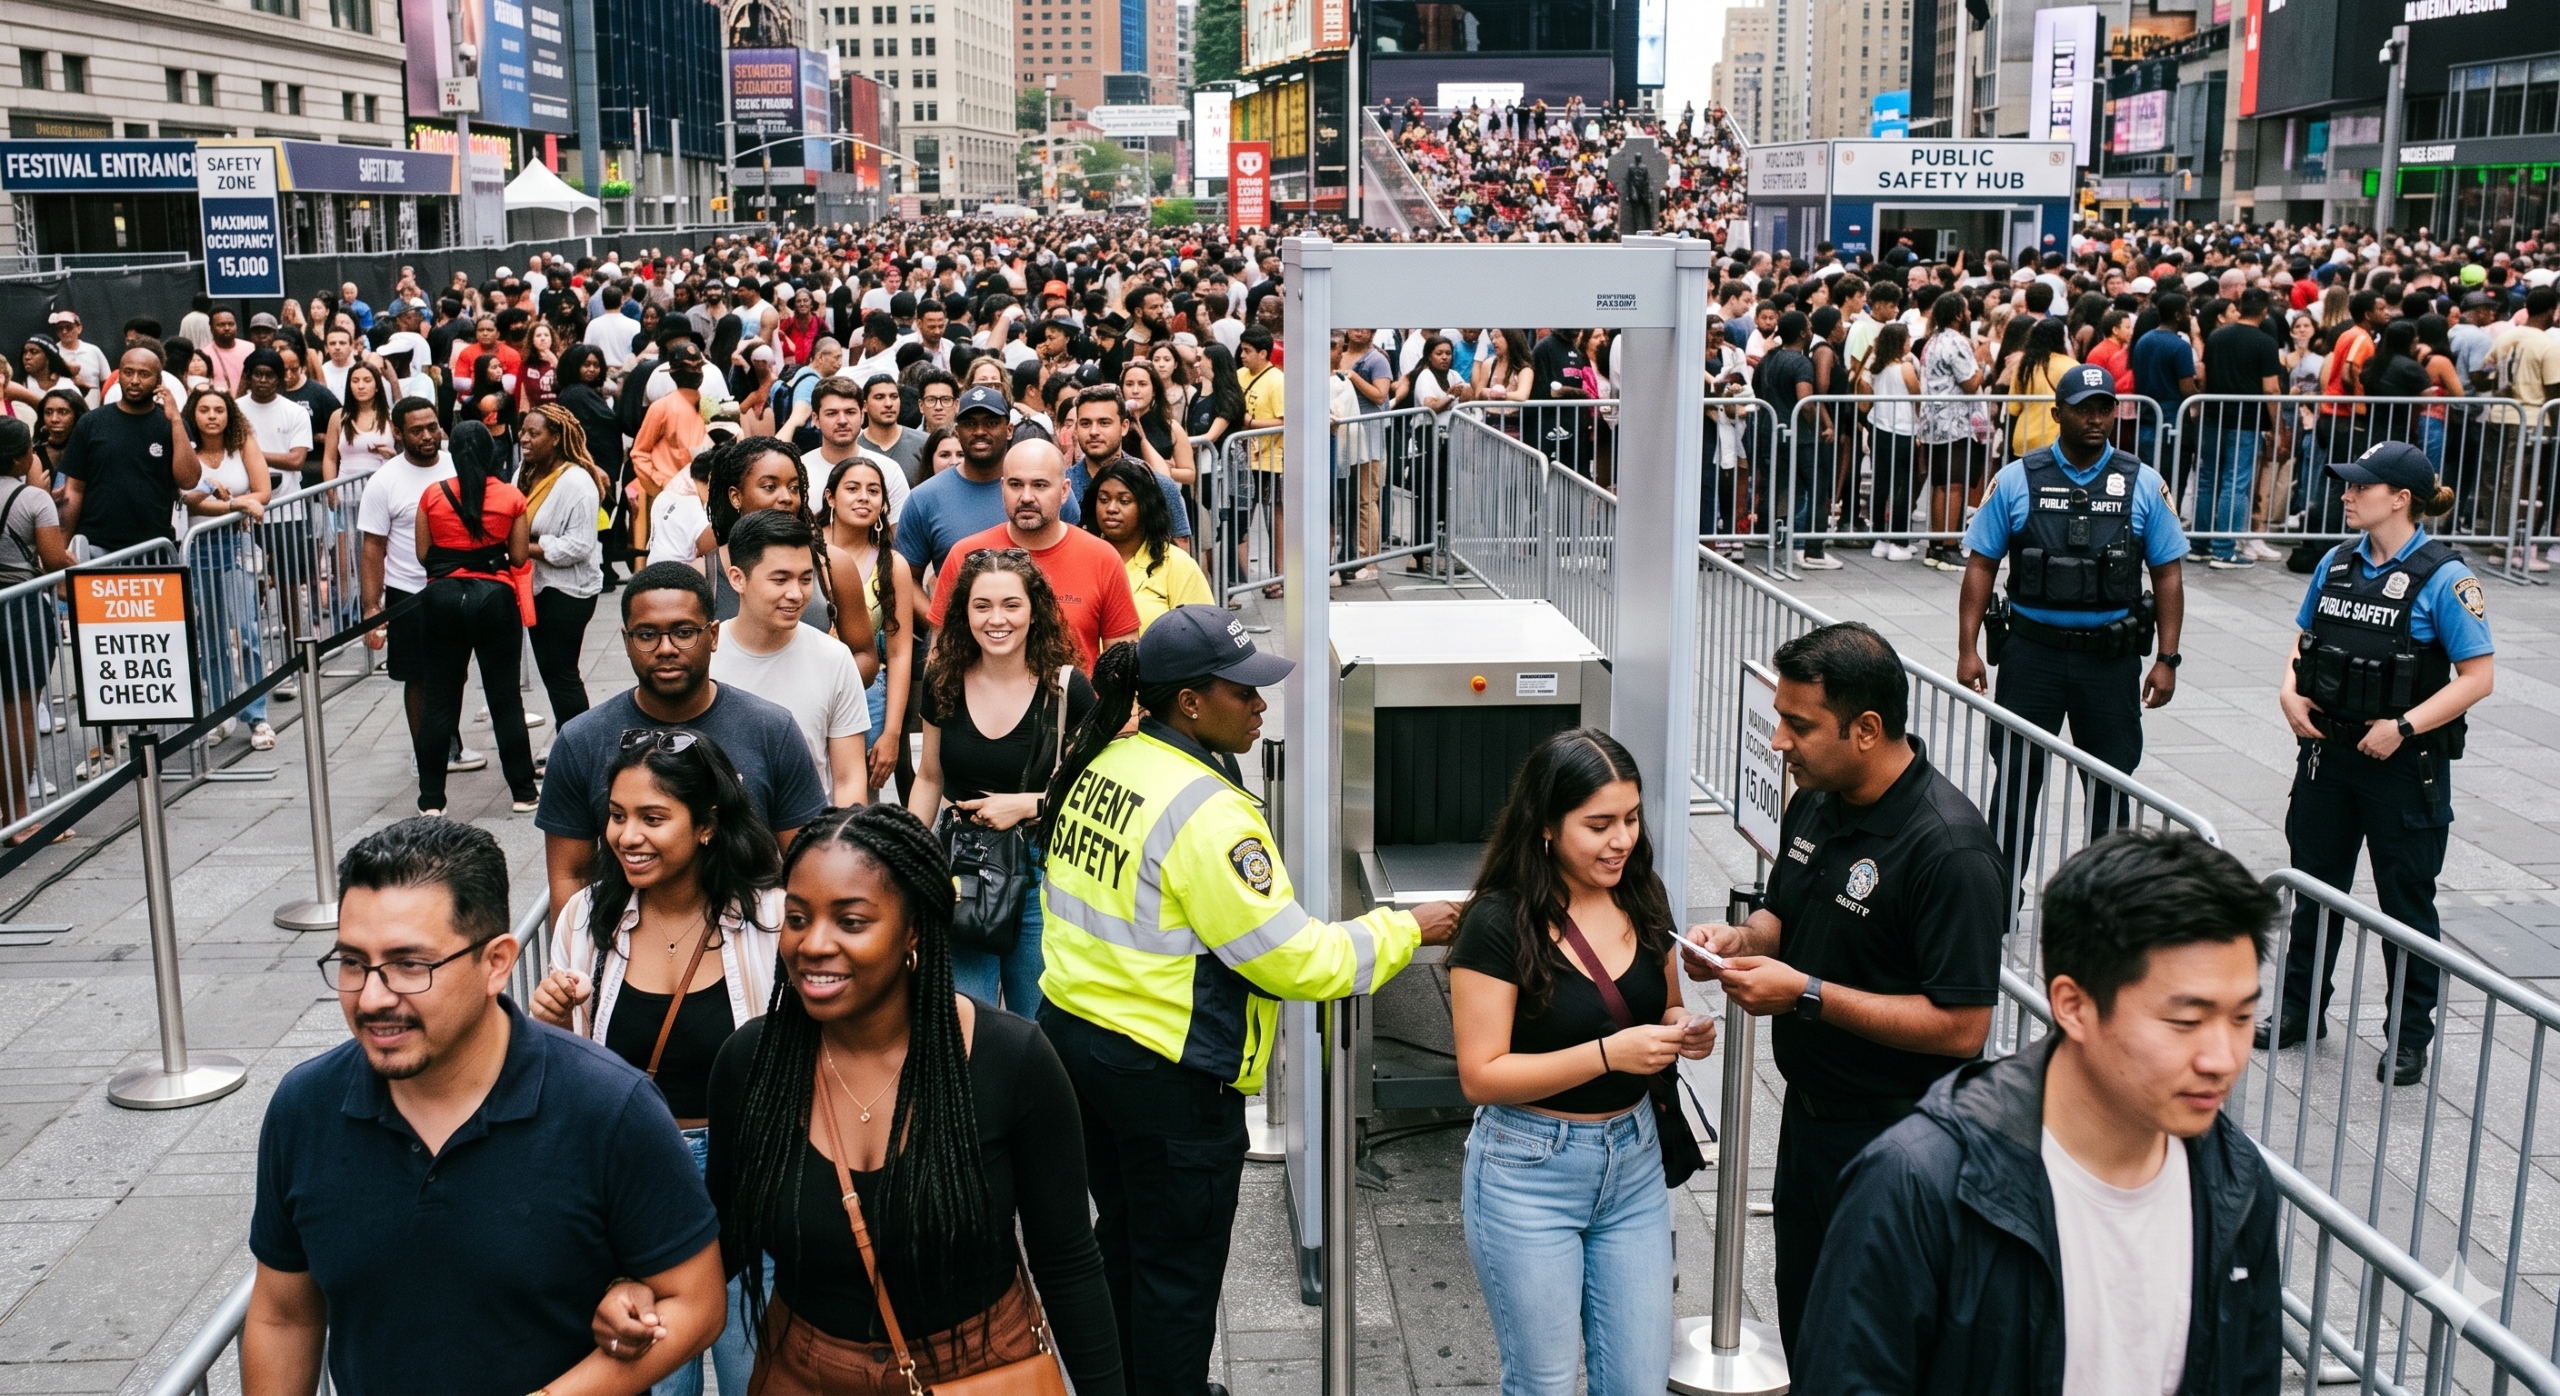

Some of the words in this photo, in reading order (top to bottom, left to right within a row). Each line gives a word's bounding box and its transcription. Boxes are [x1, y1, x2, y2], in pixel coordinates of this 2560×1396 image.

[6, 153, 98, 179] FESTIVAL
[207, 157, 261, 171] SAFETY
[1911, 149, 1994, 166] PUBLIC
[217, 175, 256, 190] ZONE
[1878, 171, 1968, 189] SAFETY
[1977, 172, 2024, 189] HUB
[211, 215, 269, 230] MAXIMUM
[207, 233, 274, 249] OCCUPANCY
[217, 256, 269, 278] 15,000
[91, 578, 165, 598] SAFETY
[104, 599, 156, 618] ZONE
[2318, 595, 2352, 618] PUBLIC
[2352, 602, 2400, 627] SAFETY
[95, 633, 170, 655] ENTRY
[99, 660, 117, 680] &
[124, 658, 172, 679] BAG
[100, 683, 178, 705] CHECK
[1068, 769, 1145, 835] EVENT
[1744, 765, 1779, 824] 15,000
[1052, 813, 1130, 890] SAFETY
